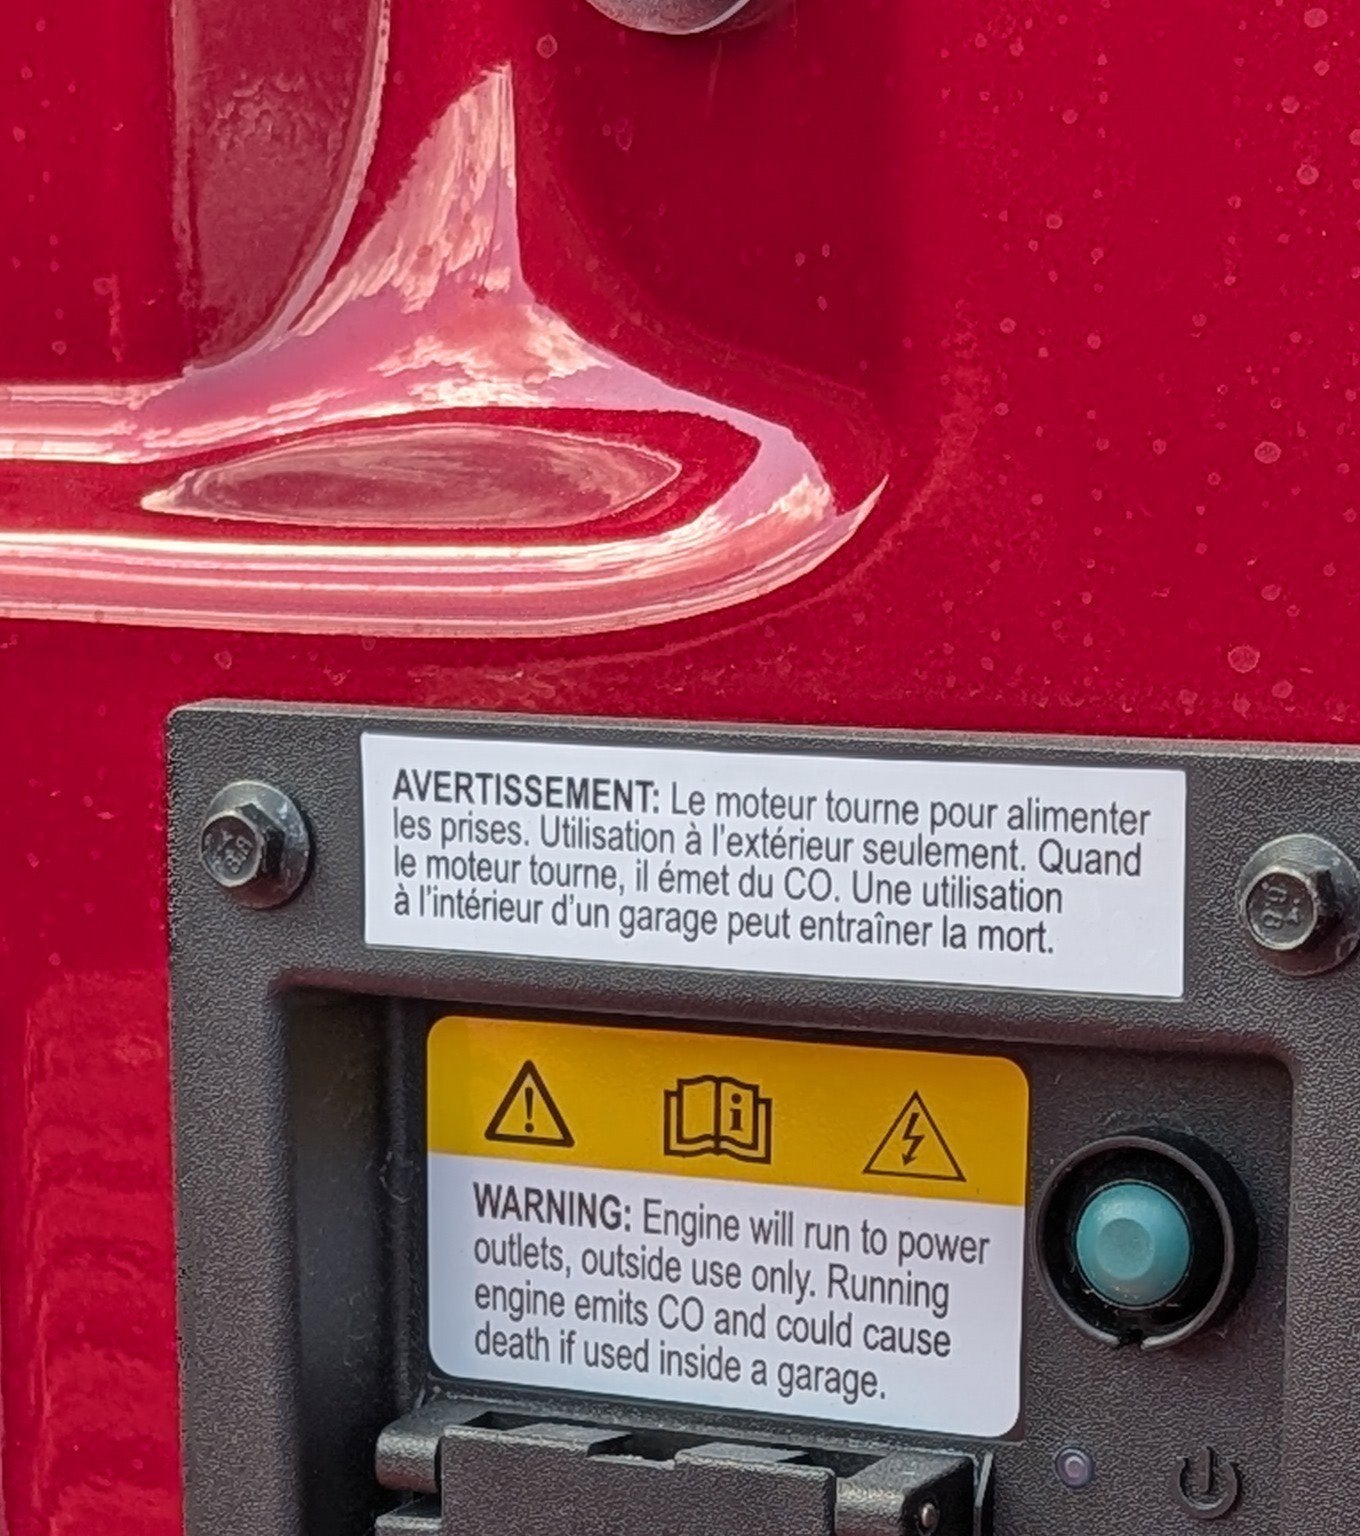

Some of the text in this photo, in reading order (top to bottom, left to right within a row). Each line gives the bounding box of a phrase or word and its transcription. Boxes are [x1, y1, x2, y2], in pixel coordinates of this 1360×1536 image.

[392, 768, 1152, 837] AVERTISSEMENT: Le moteur tourne pour alimenter
[393, 806, 1142, 878] les prises. Utilisation à l'extérieur seulement. Quand
[394, 844, 1063, 914] le moteur tourne, il émet du CO. Une utilisation
[393, 882, 1054, 955] à l'intérieur d'un garage peut entraîner la mort.
[472, 1181, 991, 1268] WARNING: Engine will run to power
[473, 1232, 950, 1320] outlets, outside use only. Running
[474, 1279, 951, 1358] engine emits CO and could cause
[474, 1320, 886, 1405] death if used inside a garage.
